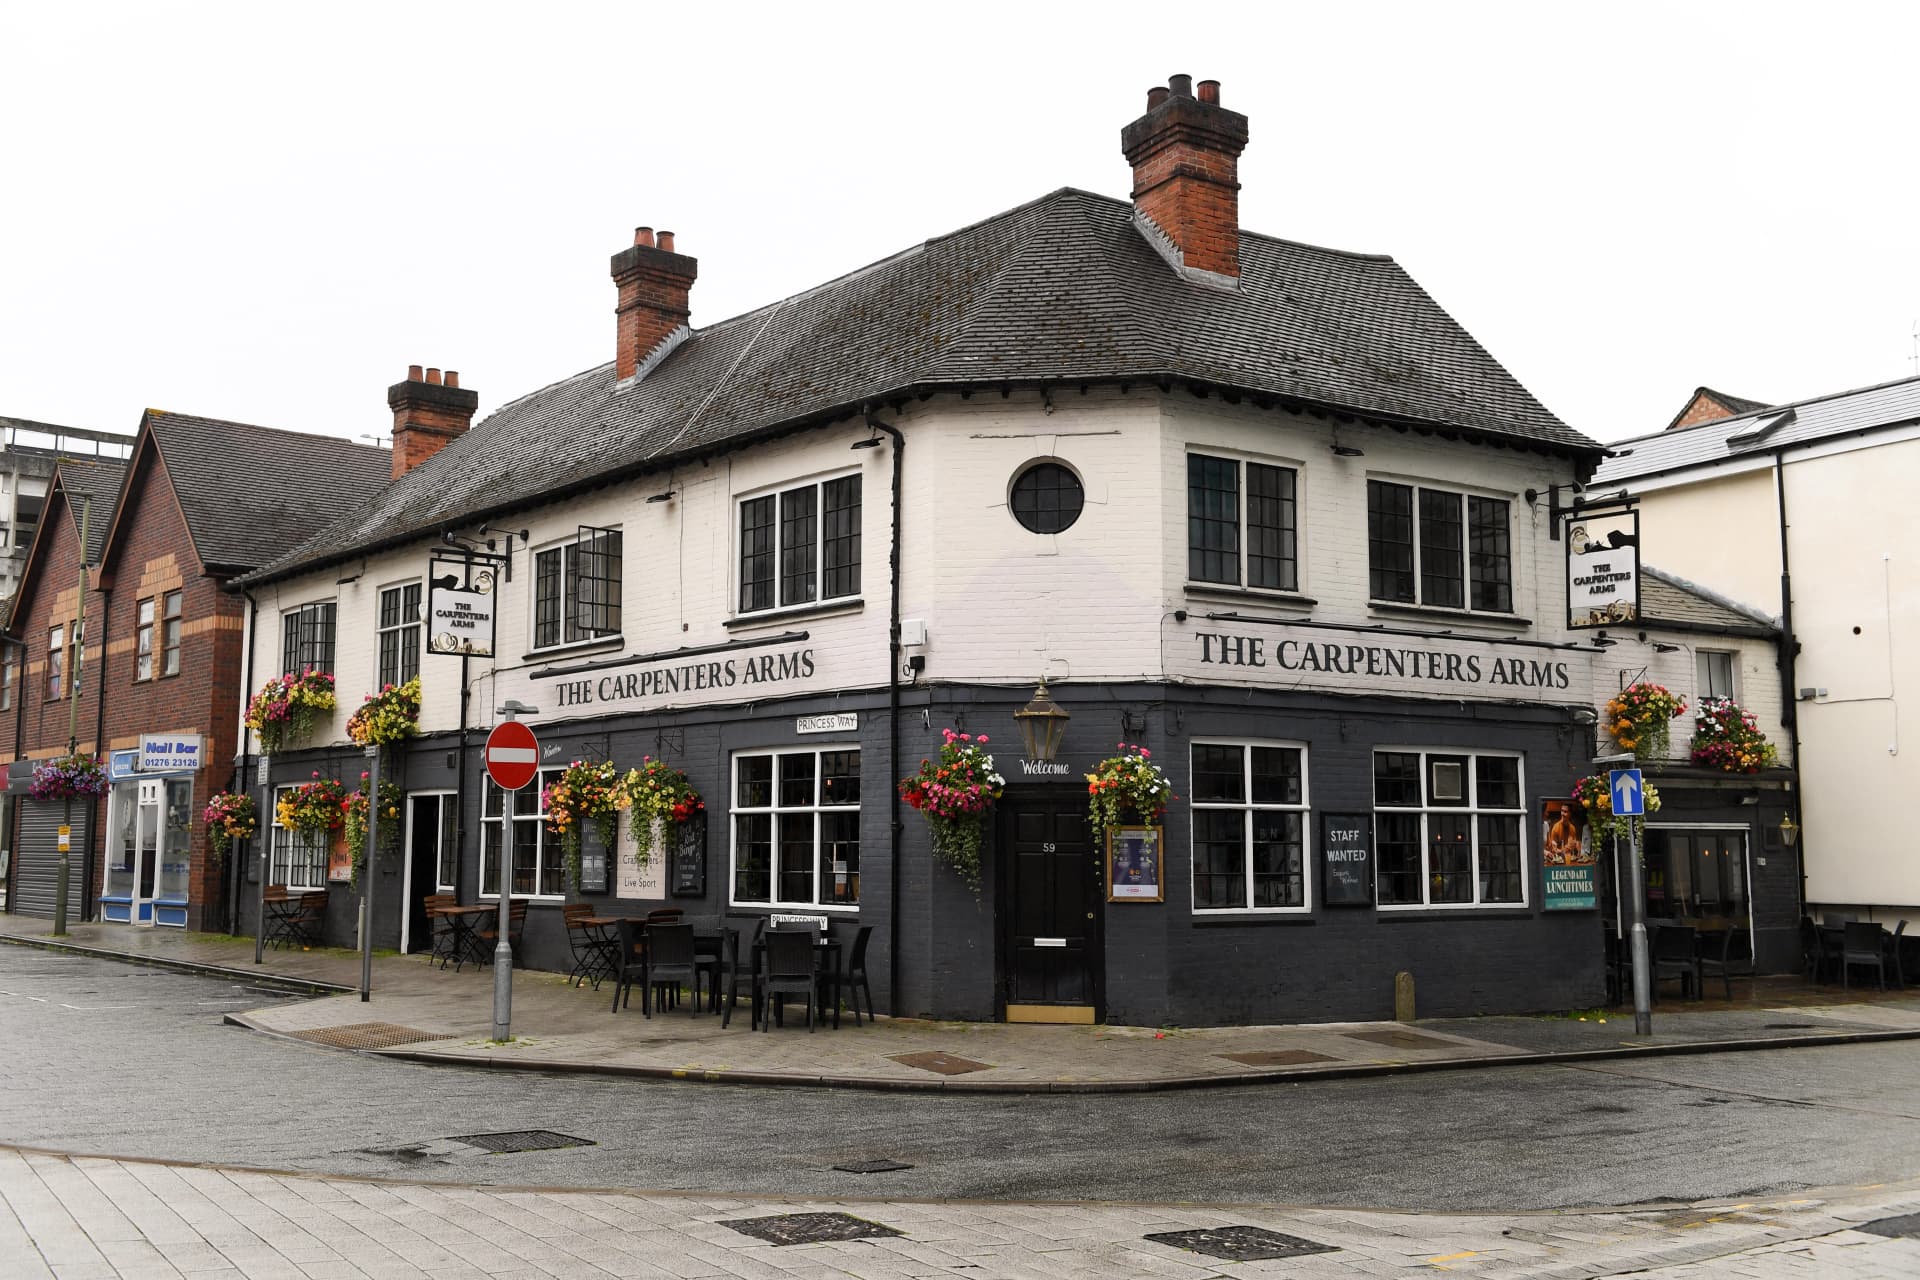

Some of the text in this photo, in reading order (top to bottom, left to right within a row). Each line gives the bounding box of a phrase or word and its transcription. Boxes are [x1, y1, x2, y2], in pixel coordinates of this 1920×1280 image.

[1592, 564, 1611, 573] THE
[1573, 572, 1631, 585] CARPENTERS
[1589, 584, 1616, 595] ARMS
[455, 602, 471, 610] THE
[436, 610, 489, 620] CARPENTERS
[450, 620, 475, 628] ARMS
[1195, 631, 1569, 690] THE CARPENTERS ARMS
[556, 649, 815, 707] THE CARPENTERS ARMS
[798, 715, 856, 731] PRINCESS WAY
[145, 742, 198, 753] Nail Bar
[145, 758, 198, 767] 01276 23126
[1019, 759, 1071, 775] Welcome
[1330, 830, 1359, 841] STAFF
[1042, 843, 1056, 853] 59
[1327, 849, 1367, 862] WANTED
[1551, 870, 1587, 880] LEGENDARY
[624, 877, 657, 889] Live Sport
[1546, 881, 1593, 894] LUNCHTIMES
